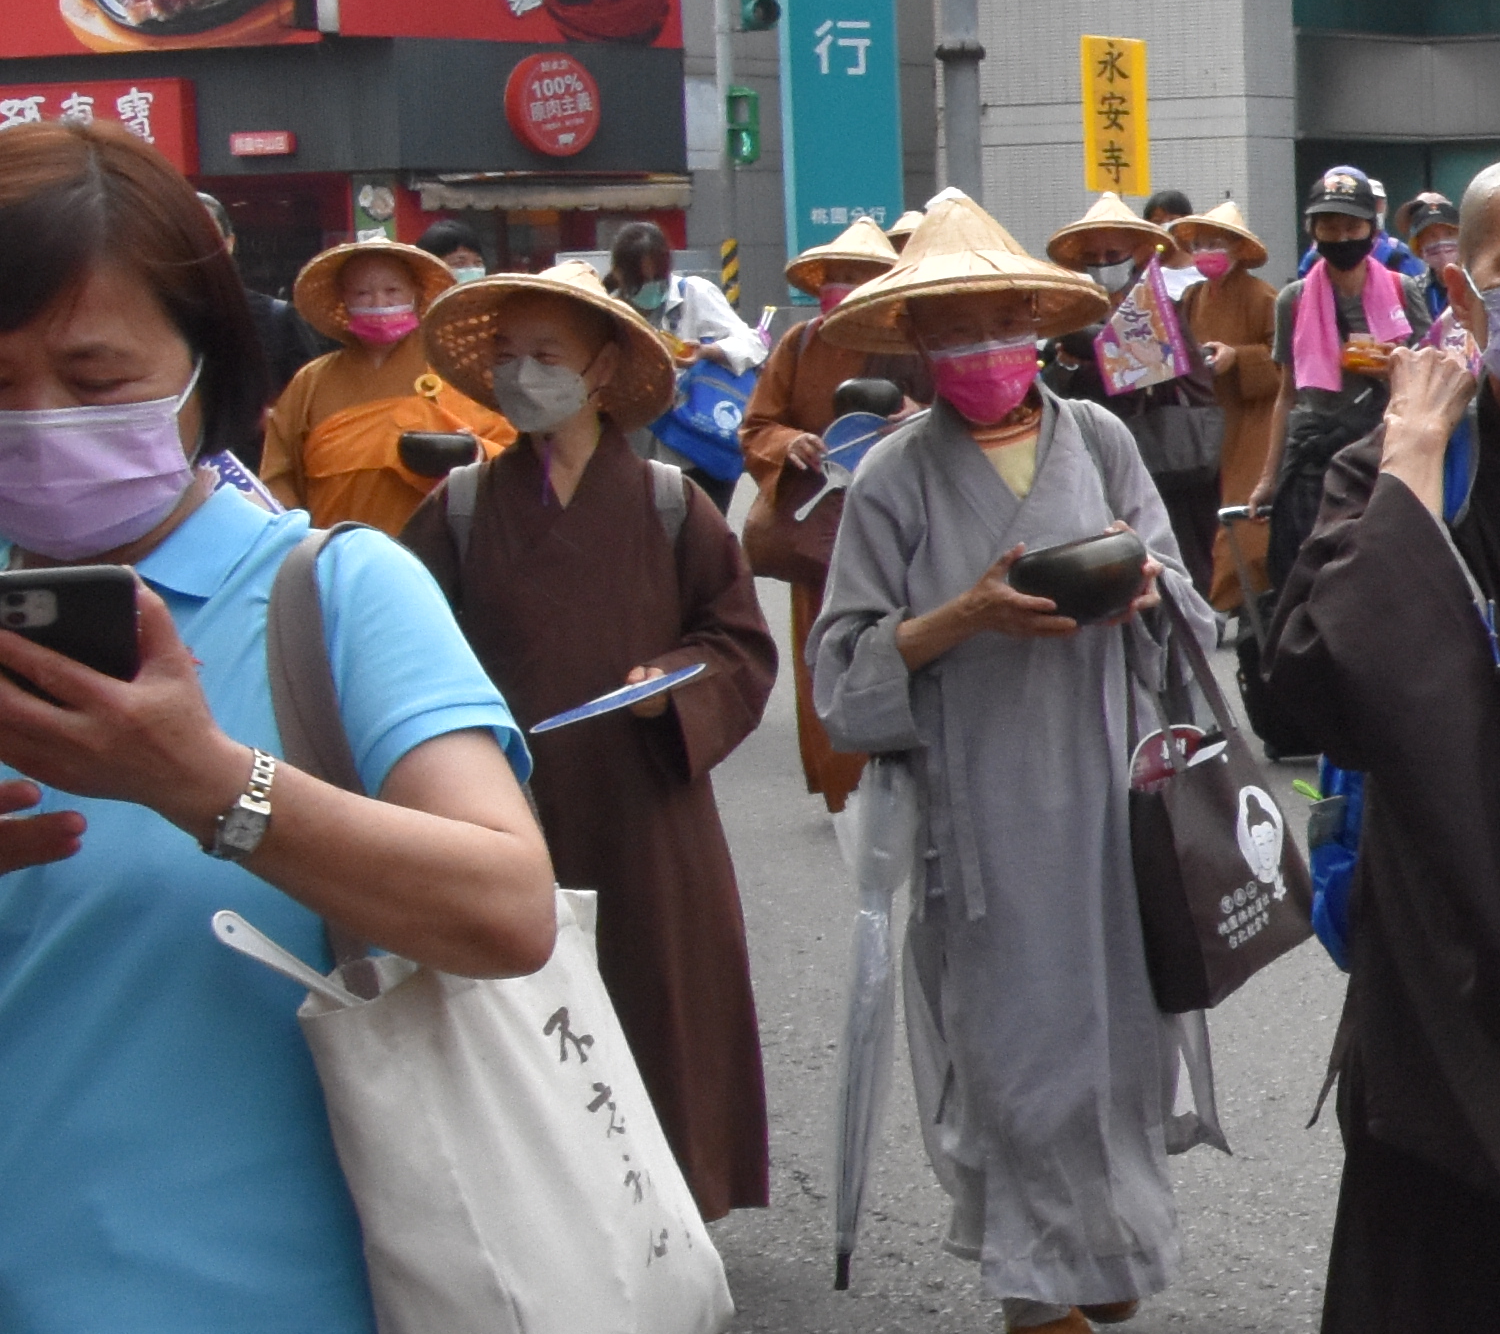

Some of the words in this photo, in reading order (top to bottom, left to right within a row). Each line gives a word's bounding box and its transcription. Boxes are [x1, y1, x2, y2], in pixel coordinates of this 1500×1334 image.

[531, 73, 584, 98] 100%
[1095, 39, 1131, 185] 永安寺
[811, 205, 887, 225] 桃園分行
